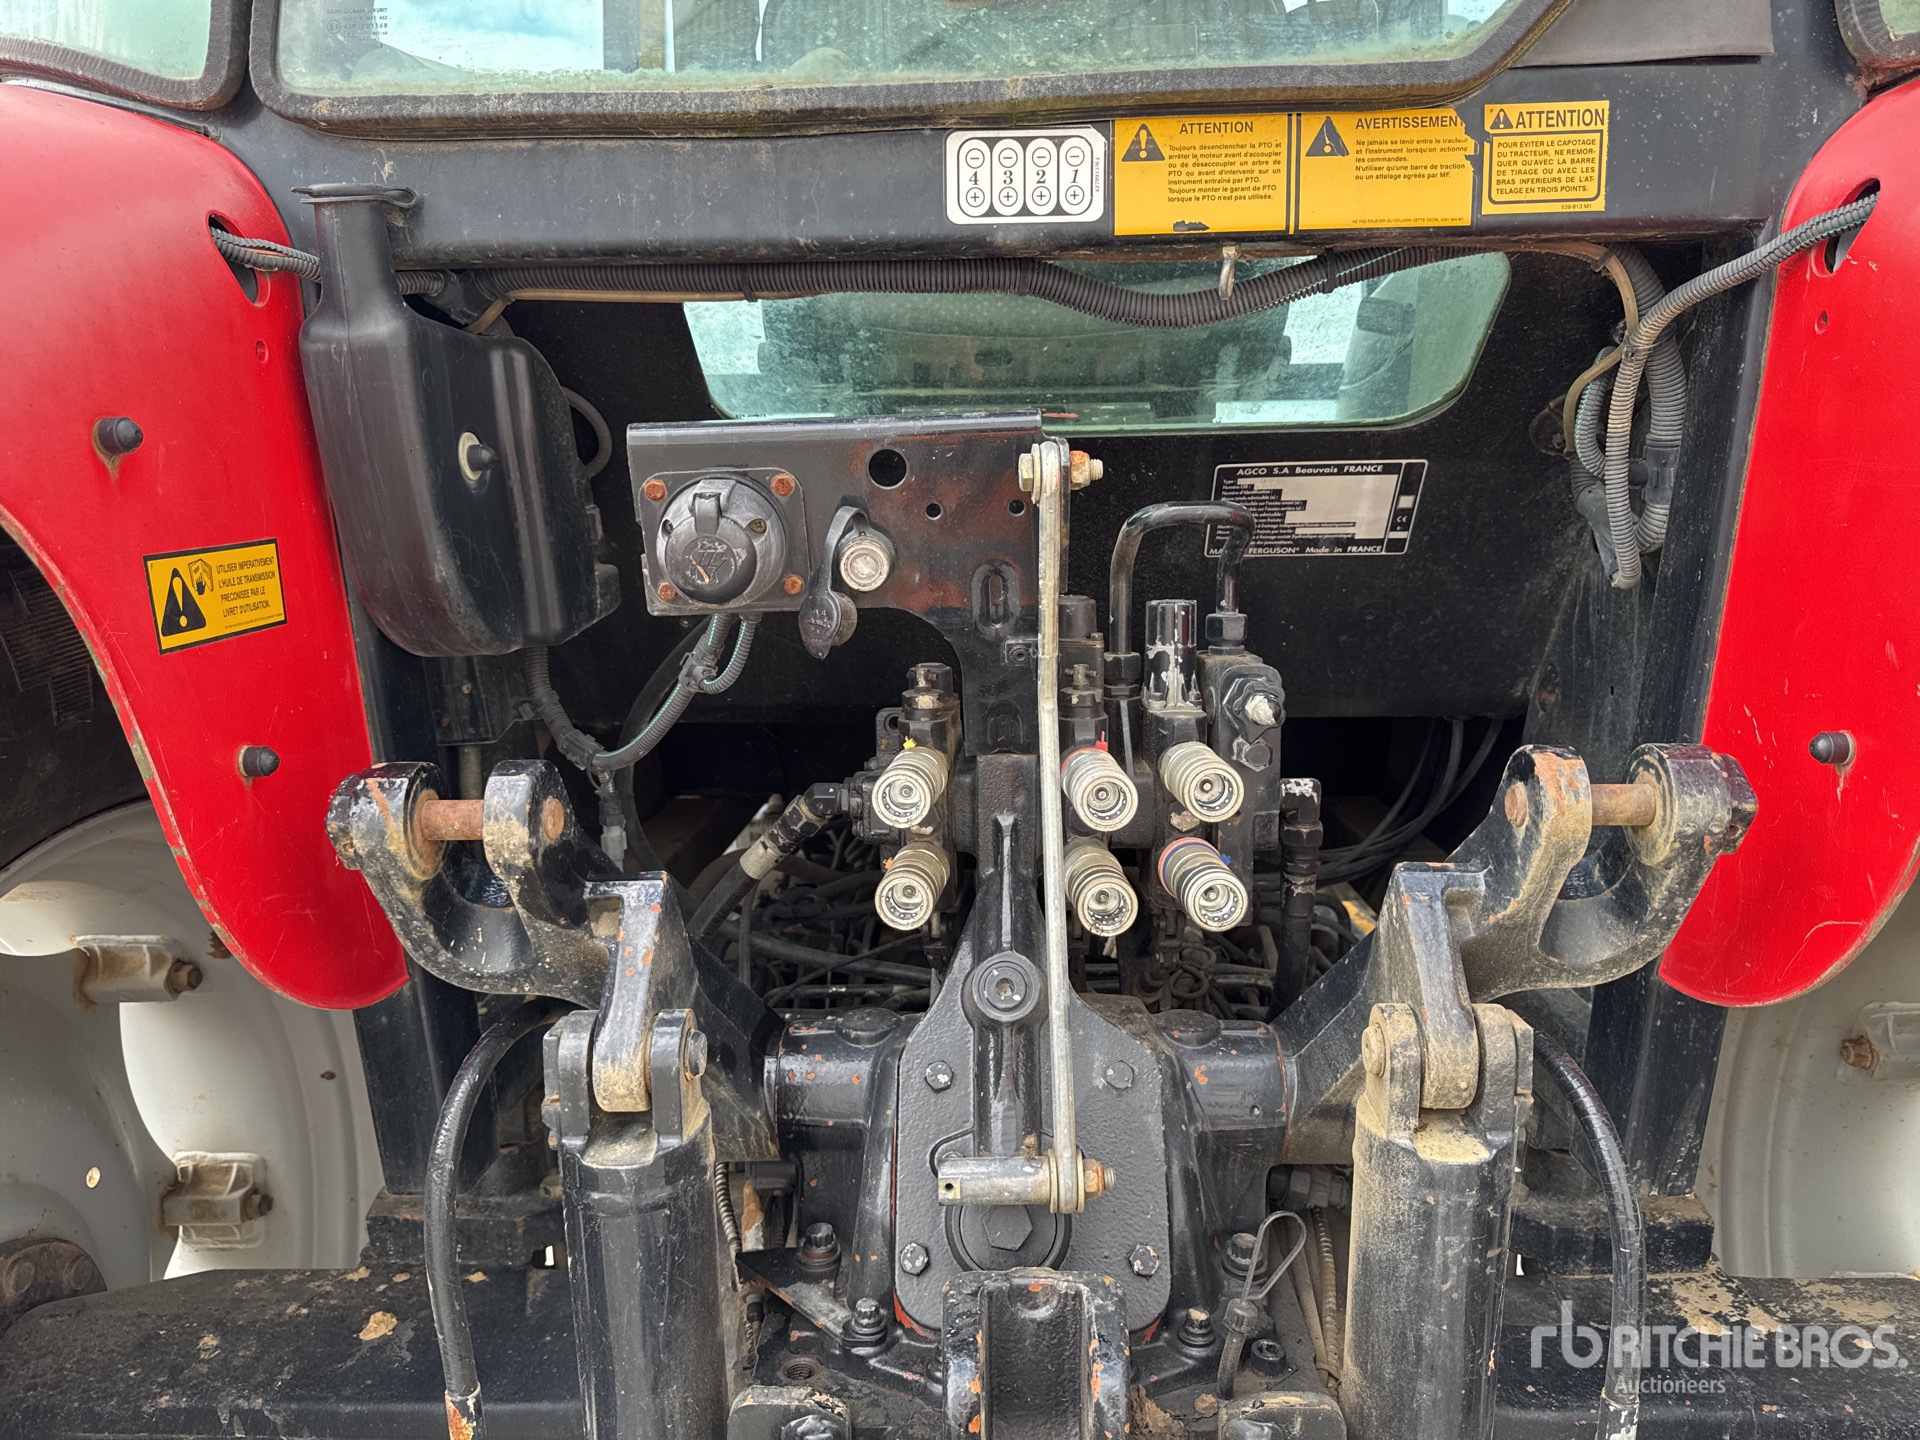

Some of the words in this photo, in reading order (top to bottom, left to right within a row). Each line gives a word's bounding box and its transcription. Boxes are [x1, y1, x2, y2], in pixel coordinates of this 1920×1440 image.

[1515, 108, 1604, 128] ATTENTION
[1180, 121, 1253, 134] ATTENTION
[1367, 139, 1388, 147] jamais
[1520, 140, 1544, 148] EVITER
[1244, 151, 1281, 159] d'accoupler
[1193, 160, 1236, 168] désaccoupler
[968, 170, 980, 186] 4
[1002, 170, 1014, 186] 3
[1035, 169, 1047, 184] 2
[1069, 168, 1080, 183] 1
[1520, 177, 1561, 185] INFERIEURS
[1168, 187, 1195, 195] Toujours
[1237, 467, 1267, 476] AGCO
[1295, 466, 1338, 474] Beauvais
[1343, 465, 1383, 473] FRANCE
[1305, 546, 1330, 554] Made
[1347, 545, 1382, 553] FRANCE
[217, 562, 237, 574] UTILISER
[238, 556, 274, 570] IMPERATIVEMENT
[237, 576, 243, 585] DE
[244, 571, 275, 584] TRANSMISSION
[221, 589, 250, 603] PRECONISEE
[251, 588, 259, 596] PAR
[260, 586, 265, 595] LE
[223, 606, 238, 617] LIVRET
